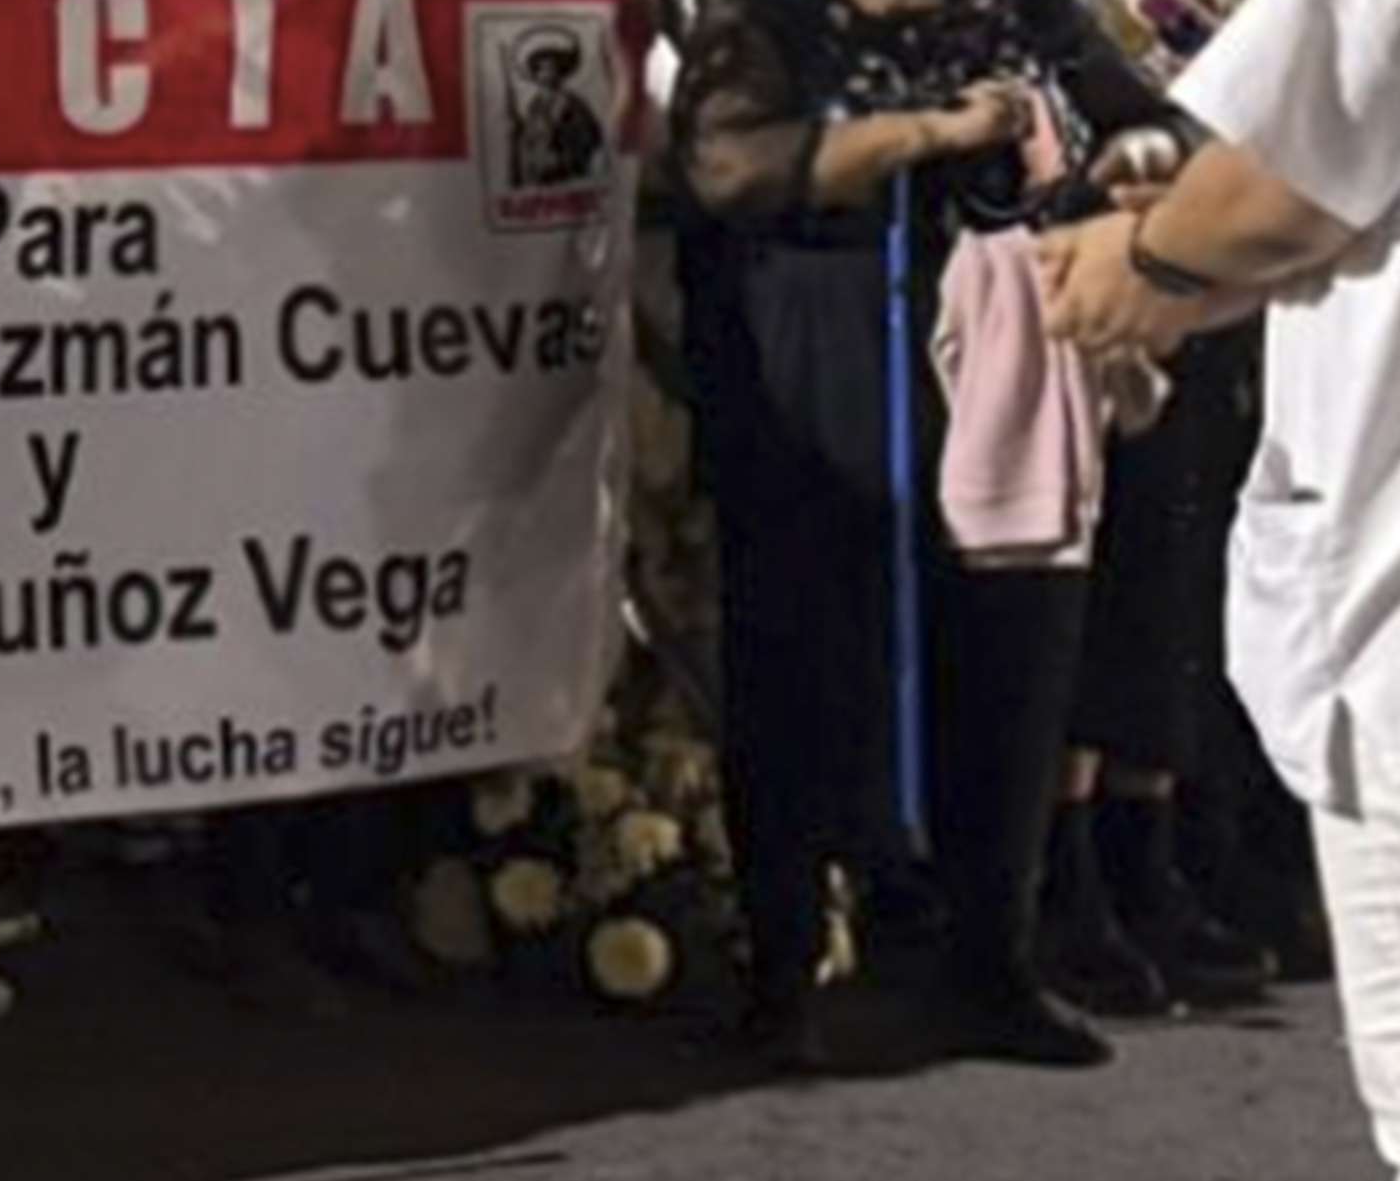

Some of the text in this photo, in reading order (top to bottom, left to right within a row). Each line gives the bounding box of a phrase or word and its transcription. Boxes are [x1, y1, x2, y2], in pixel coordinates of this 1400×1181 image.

[275, 293, 605, 382] Cuevas
[27, 431, 81, 533] y
[241, 533, 471, 653] Vega
[35, 729, 93, 797] la
[111, 715, 299, 789] lucha
[319, 682, 498, 777] sigue!
